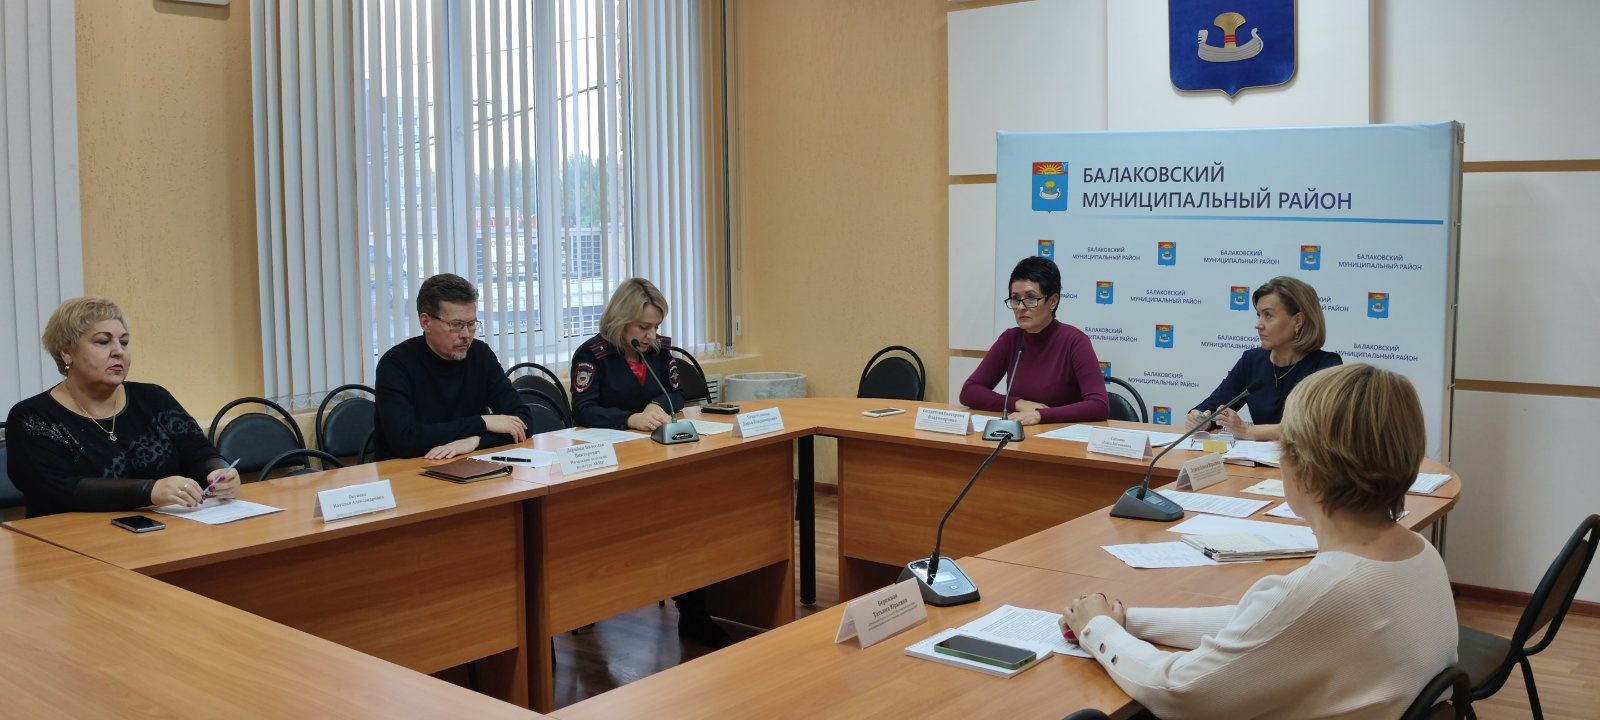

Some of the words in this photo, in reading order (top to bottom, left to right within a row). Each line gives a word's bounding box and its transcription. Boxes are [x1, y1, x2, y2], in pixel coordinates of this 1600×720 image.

[1083, 162, 1225, 183] БАЛАКОВСКИЙ
[1082, 187, 1271, 211] МУНИЦИПАЛЬНЫЙ
[1278, 188, 1352, 210] РАЙОН
[1338, 261, 1398, 270] МУНИЦИПАЛЬНЫЙ
[1399, 263, 1422, 271] РАЙОН
[1130, 296, 1181, 304] МУНИЦИПАЛЬНЫЙ
[1119, 335, 1138, 343] РАЙОН
[1217, 334, 1260, 342] БАЛАКОВСКИЙ
[1353, 343, 1400, 351] БАЛАКОВСКИЙ
[1395, 354, 1419, 362] РАЙОН
[1143, 370, 1183, 379] БАЛАКОВСКИЙ
[1128, 377, 1179, 386] МУНИЦИПАЛЬНЫЙ
